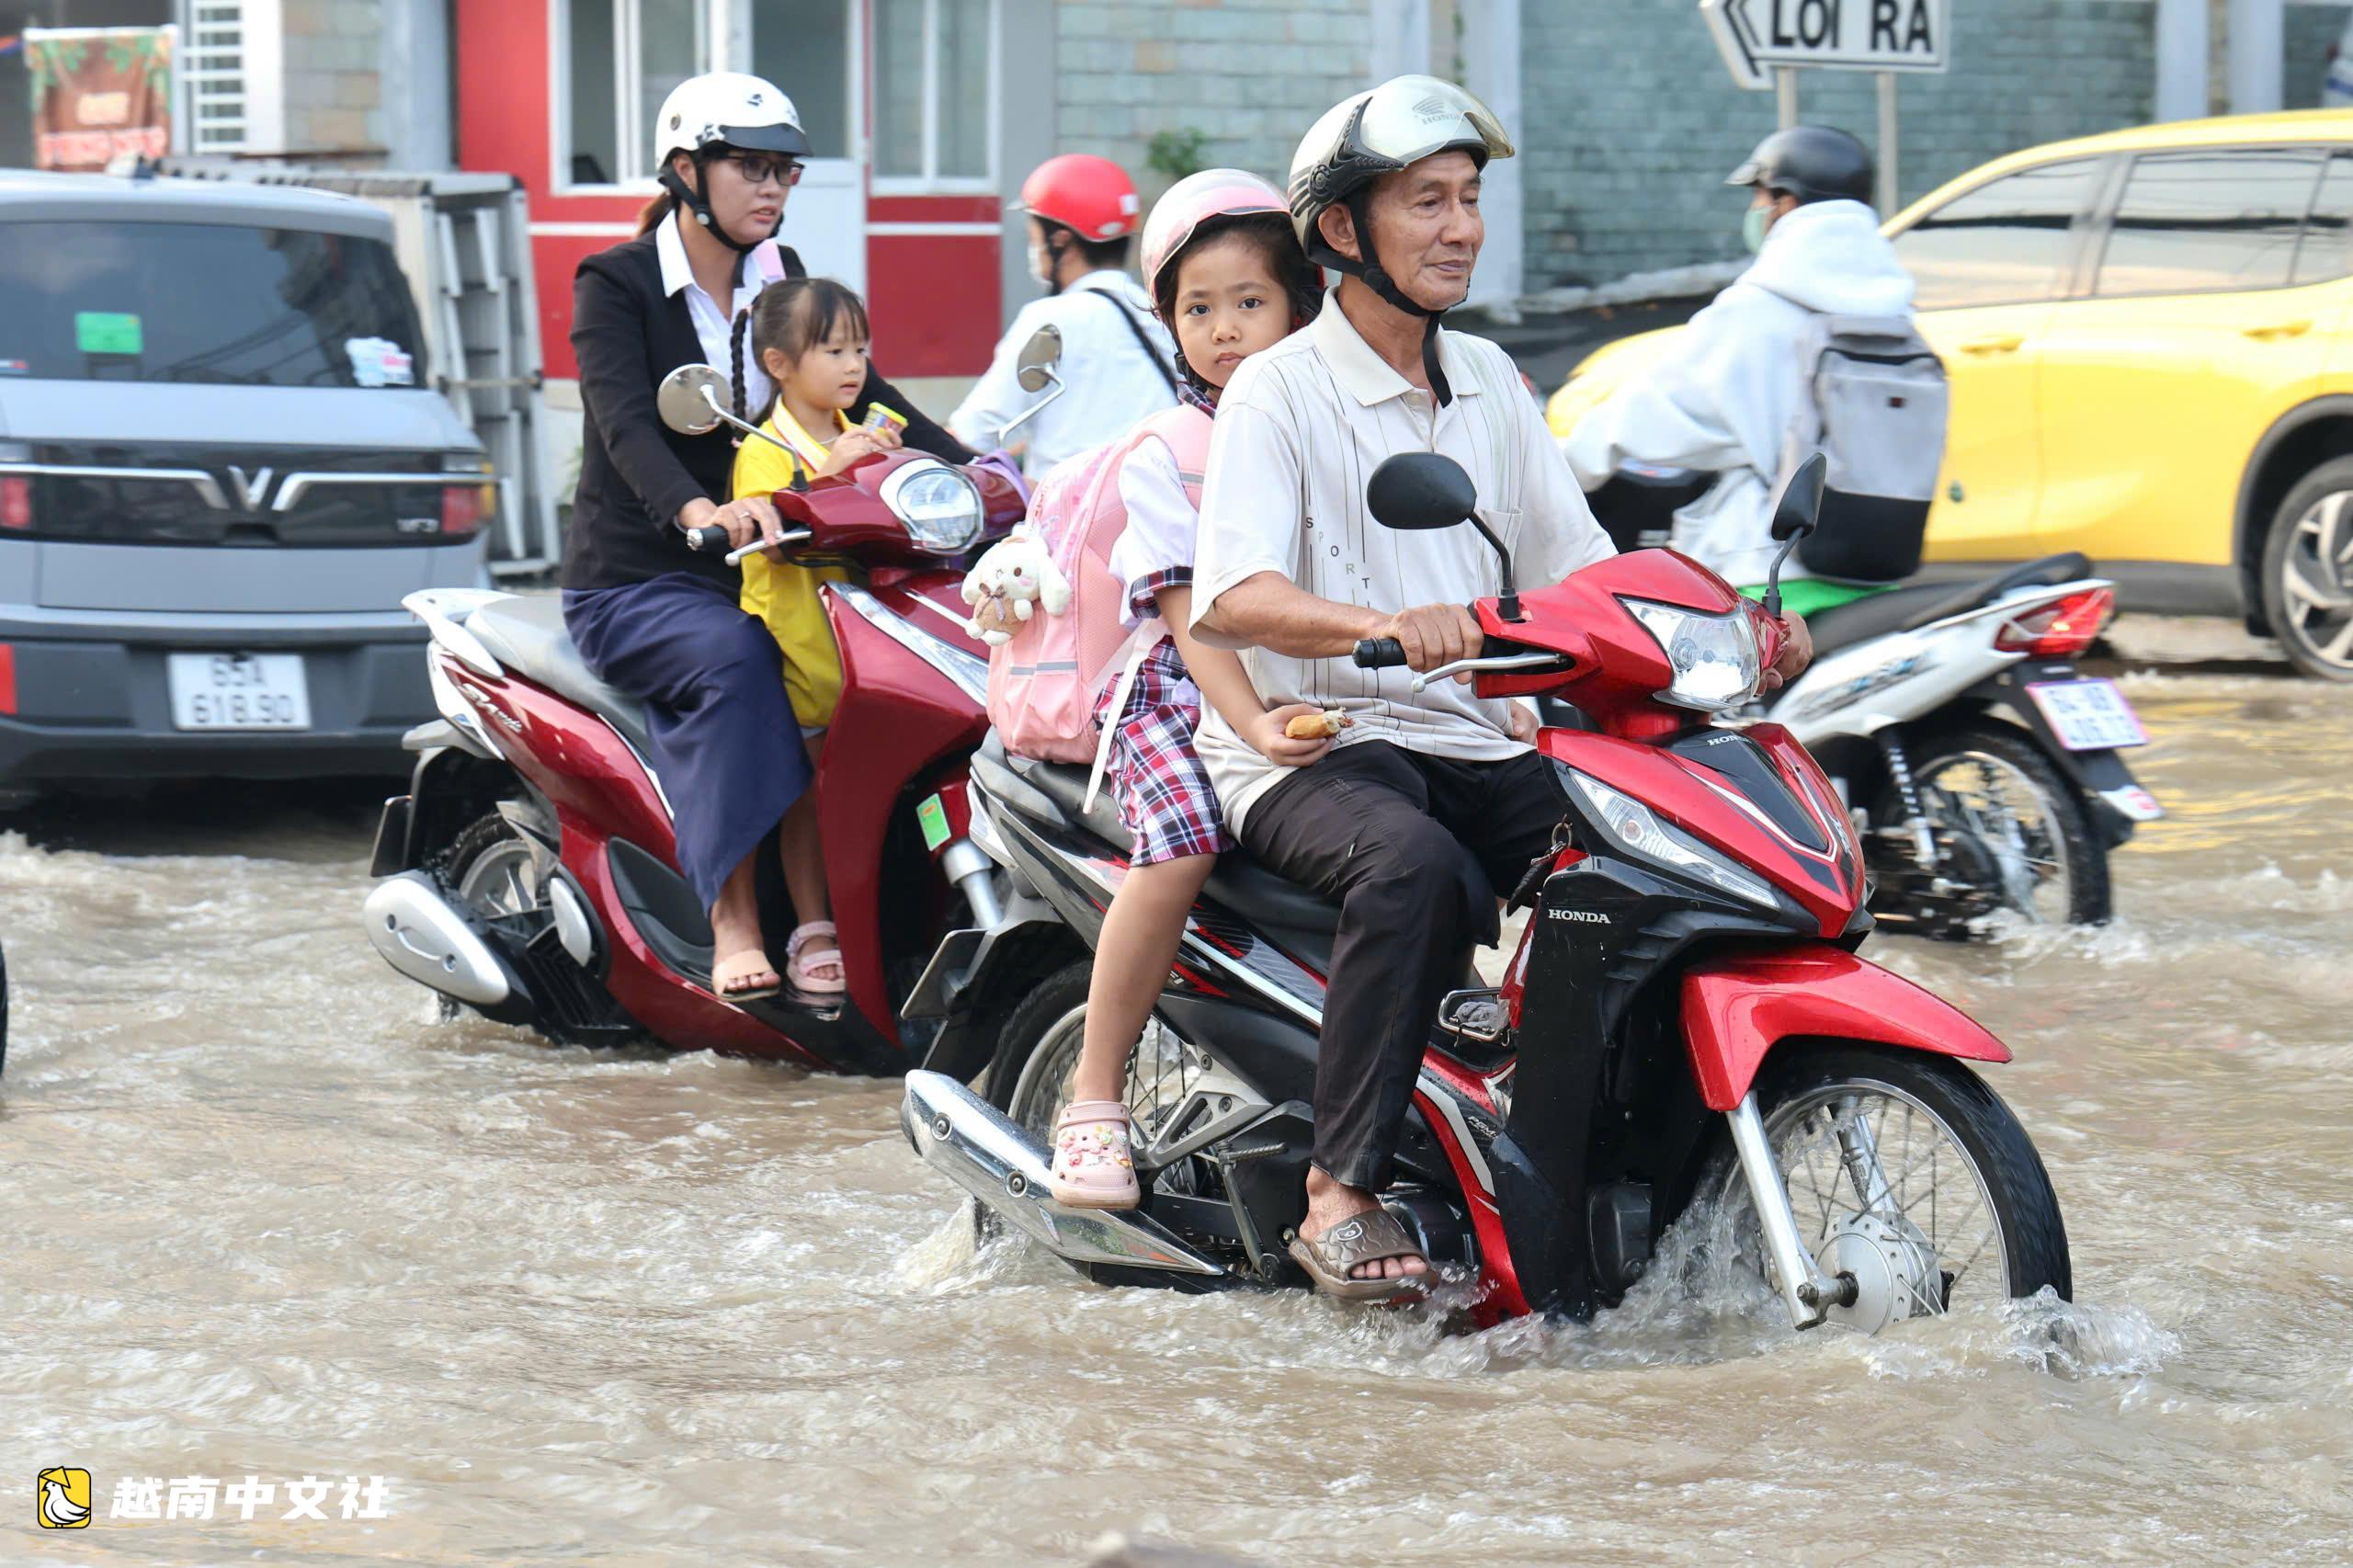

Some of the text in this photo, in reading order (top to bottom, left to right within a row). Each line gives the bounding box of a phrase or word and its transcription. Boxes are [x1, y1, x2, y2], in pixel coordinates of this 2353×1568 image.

[1870, 0, 1933, 52] RA
[1305, 517, 1370, 589] SPORT
[1548, 908, 1611, 925] HONDA
